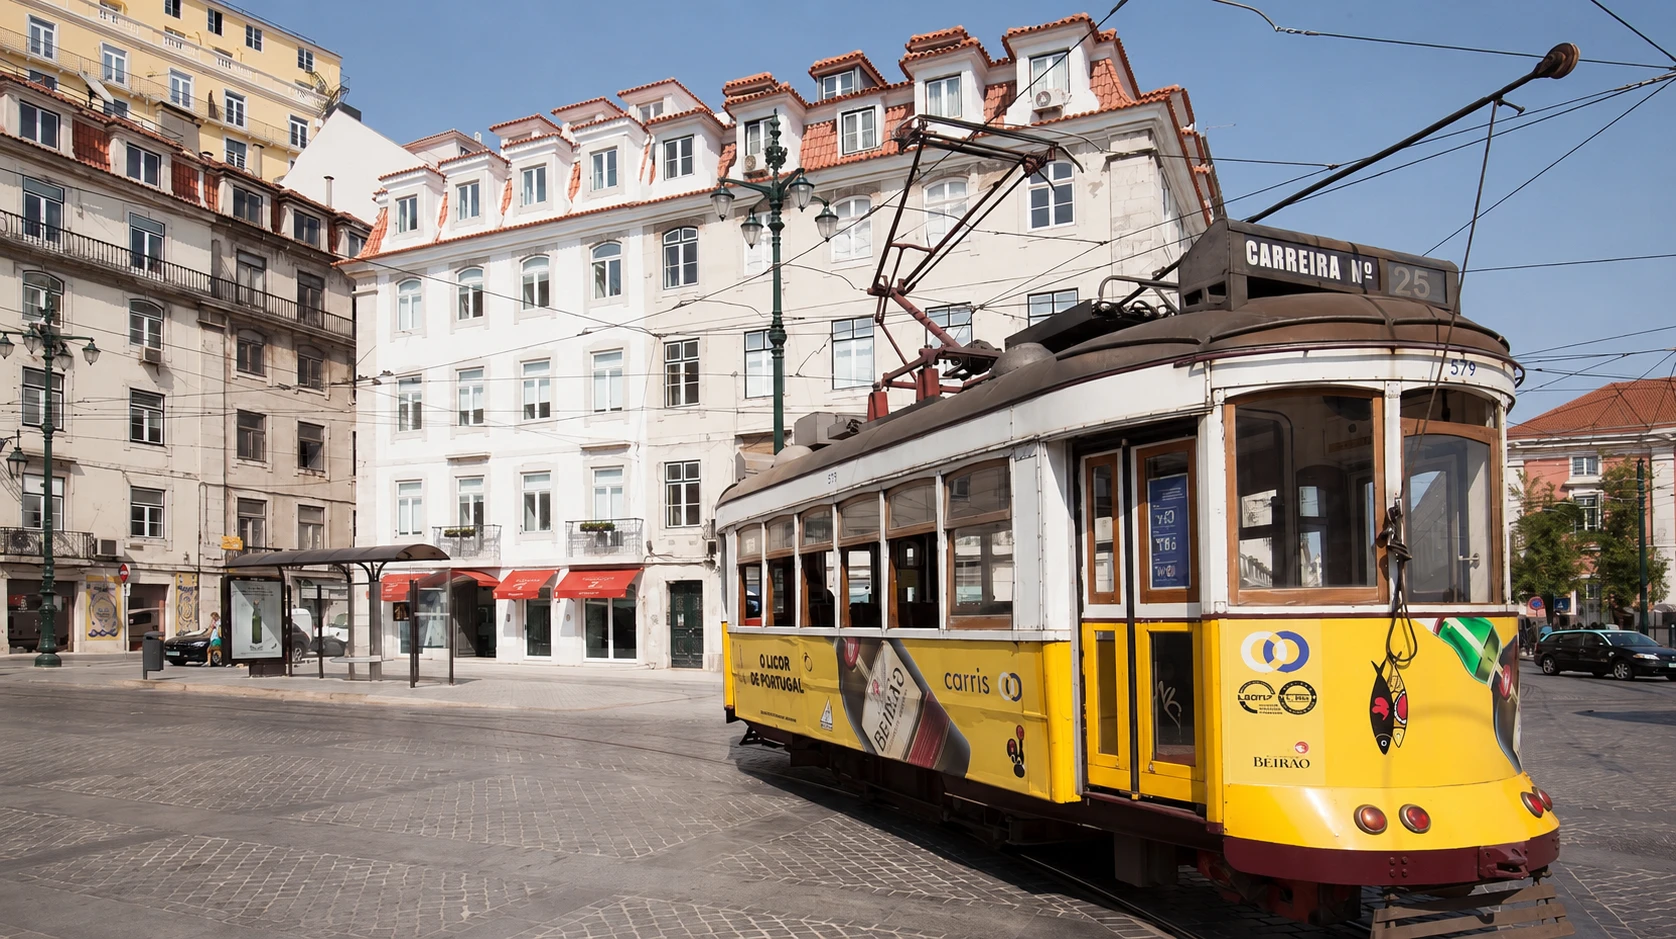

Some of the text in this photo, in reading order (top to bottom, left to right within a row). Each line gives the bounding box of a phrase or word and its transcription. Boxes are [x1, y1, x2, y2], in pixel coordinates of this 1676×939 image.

[1245, 239, 1341, 281] CARREIRA
[1393, 266, 1431, 298] 25
[1450, 359, 1476, 376] 579
[759, 653, 791, 672] O LICOR
[750, 671, 805, 694] DE PORTUGAL
[944, 667, 990, 695] carris
